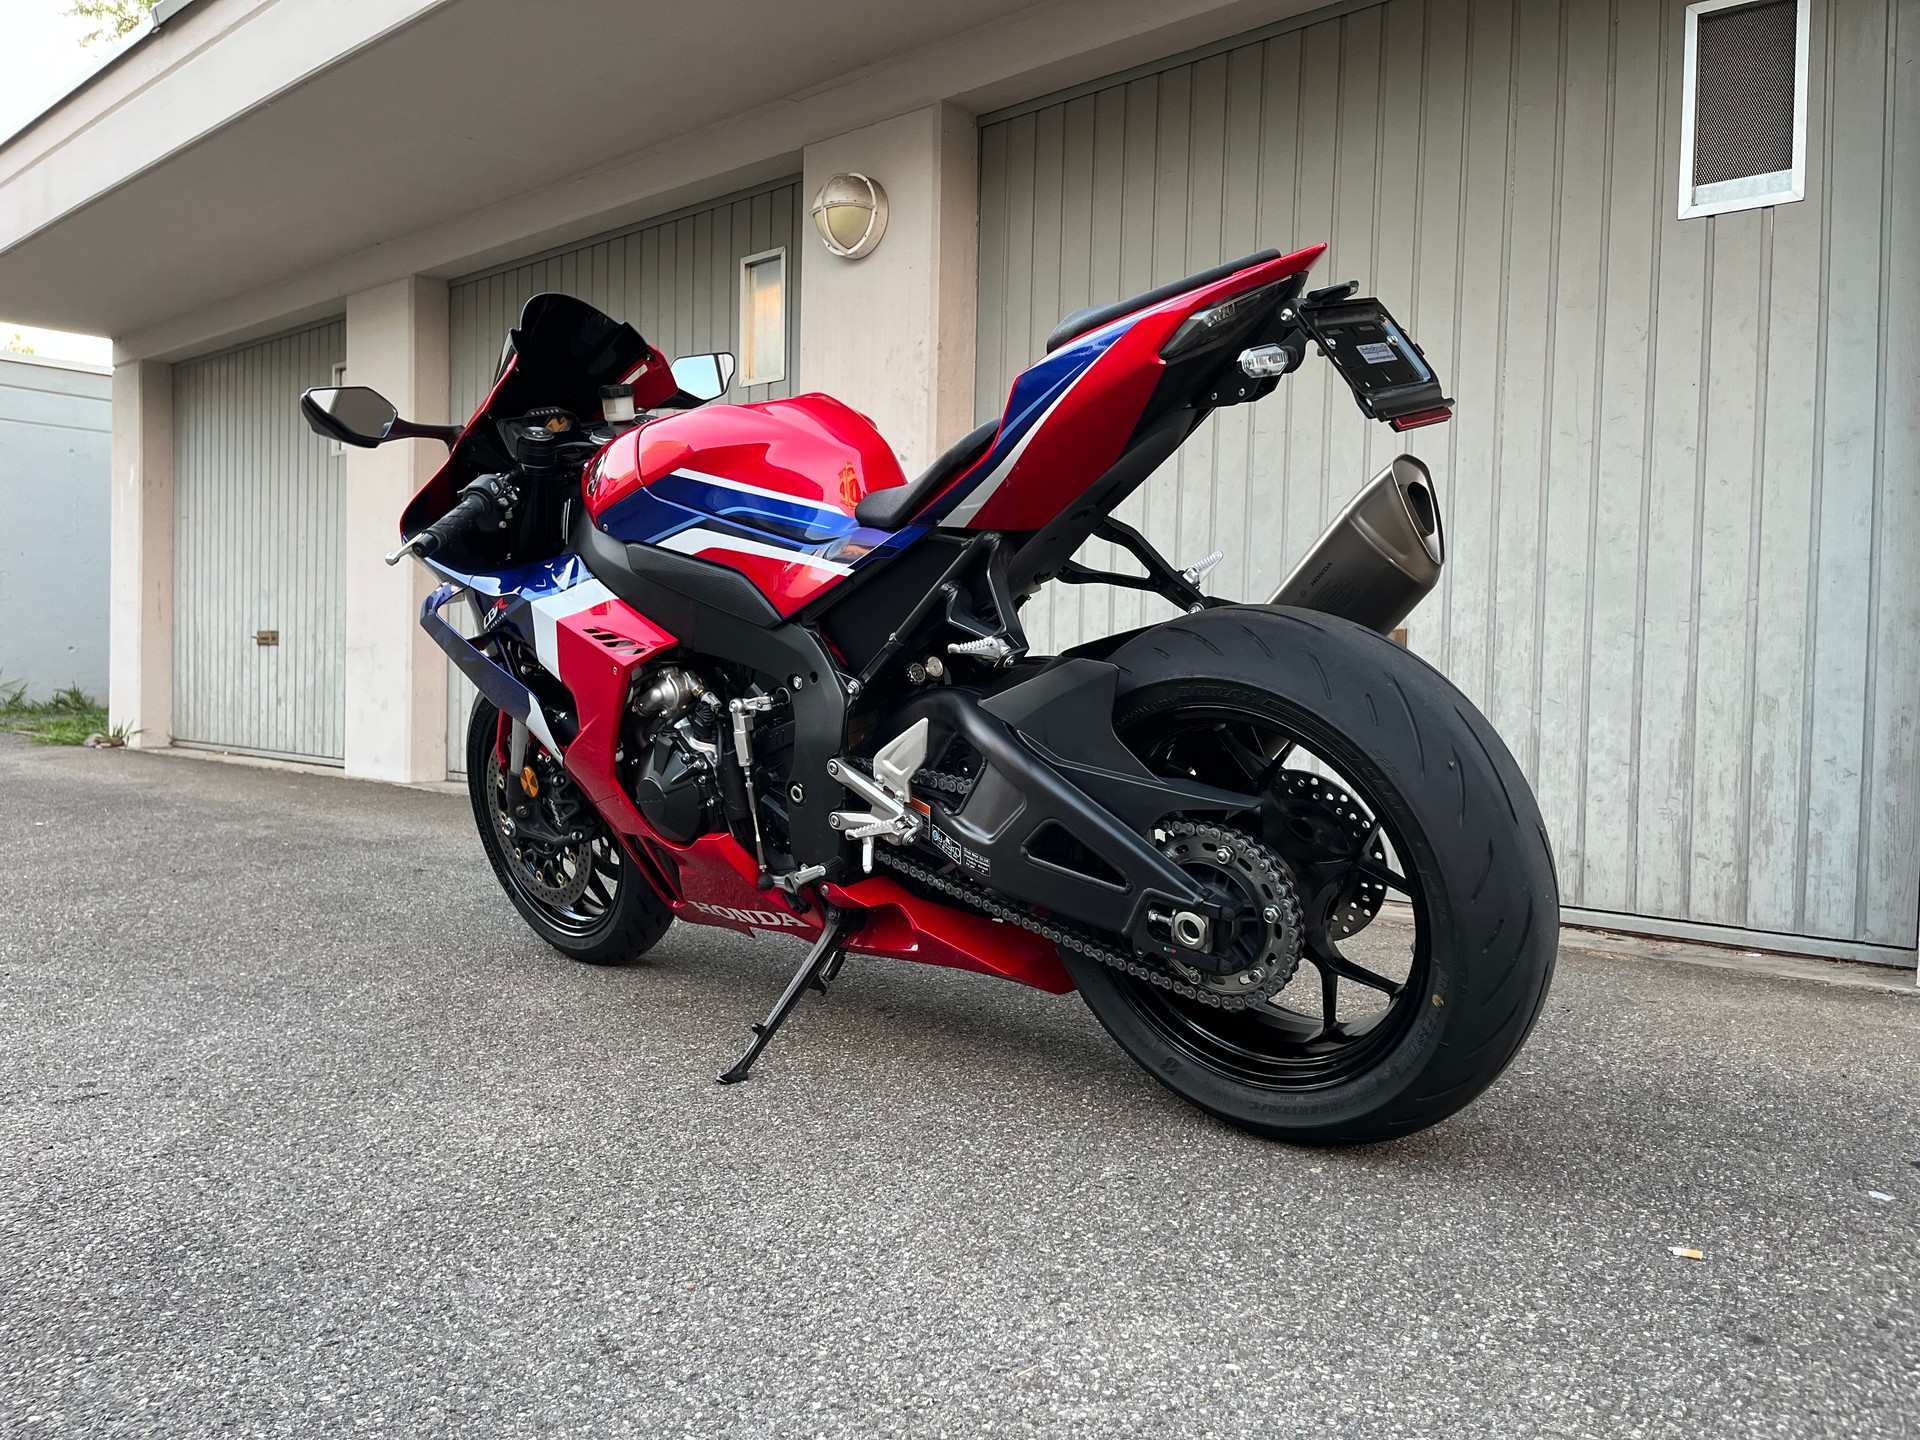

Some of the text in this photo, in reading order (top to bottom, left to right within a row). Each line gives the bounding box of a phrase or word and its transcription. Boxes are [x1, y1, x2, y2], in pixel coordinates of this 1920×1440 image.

[1310, 562, 1333, 587] HONDA
[687, 900, 811, 928] HONDA
[1394, 966, 1451, 1076] BRDGESTONE
